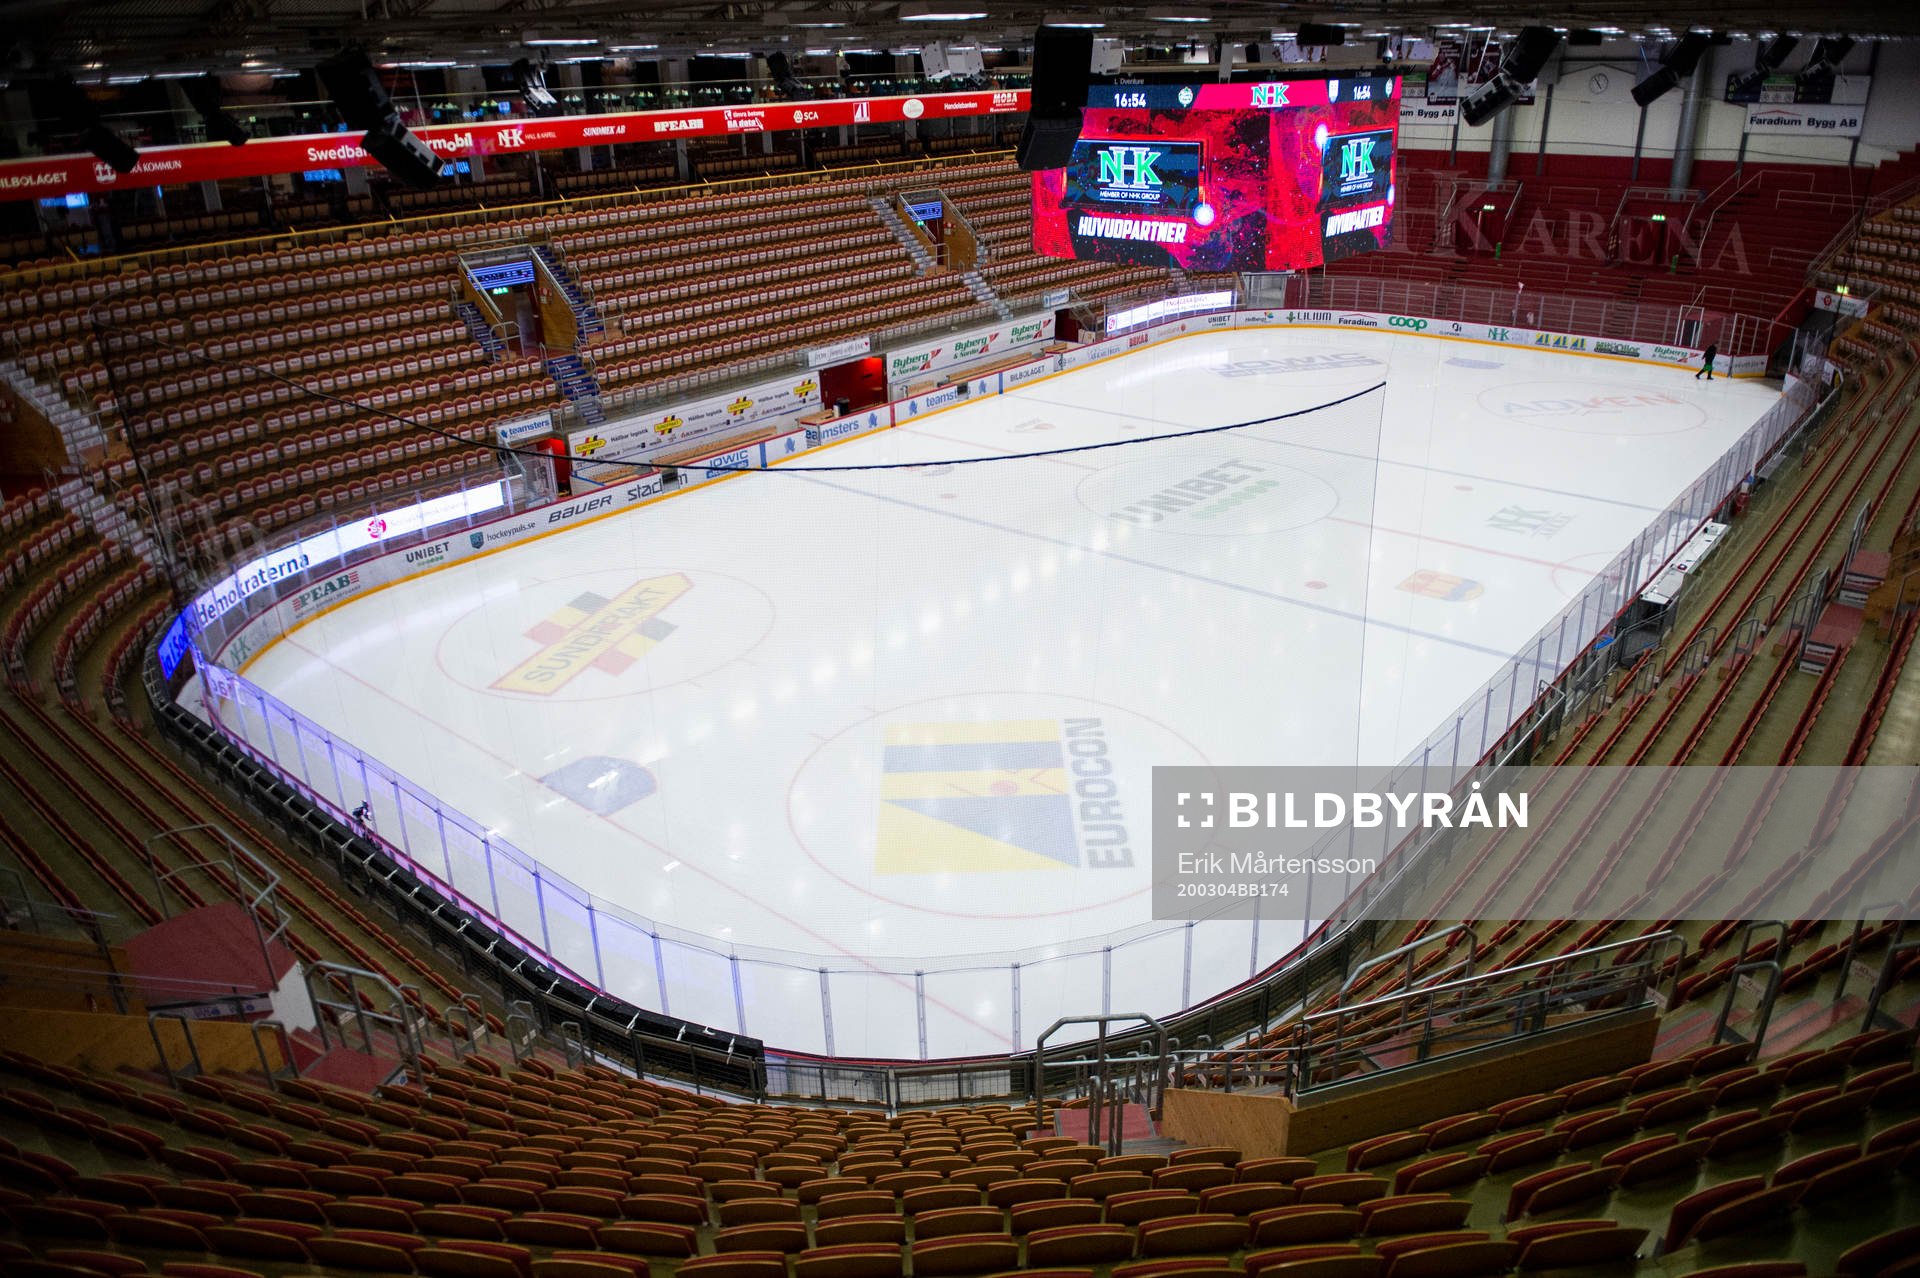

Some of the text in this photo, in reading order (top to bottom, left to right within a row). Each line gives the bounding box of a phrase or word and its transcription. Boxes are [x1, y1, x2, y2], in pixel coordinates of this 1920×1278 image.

[1114, 93, 1146, 107] 16:54
[803, 112, 819, 120] SCA
[1418, 110, 1439, 118] Bygg
[1750, 116, 1857, 128] Faradium Bygg AB
[143, 160, 182, 173] KOMMUN
[1097, 145, 1163, 189] NHK
[1099, 190, 1120, 198] MEMBER
[1141, 192, 1160, 200] GROUP
[1077, 216, 1187, 243] HUVUDPARTNER
[1515, 206, 1753, 275] ARENA
[1208, 315, 1231, 324] UNIBET
[1297, 311, 1332, 321] LILIUM
[1338, 317, 1377, 327] Faradium
[1388, 316, 1427, 331] coop
[1011, 320, 1042, 337] Byberg
[954, 336, 988, 353] Byberg
[1654, 345, 1688, 357] Byberg
[893, 352, 929, 370] Byberg
[1010, 365, 1045, 382] BILBOLAGET
[508, 419, 550, 435] teamsters
[1109, 457, 1266, 524] UNIBET
[548, 495, 612, 524] BAUER
[487, 521, 536, 542] hockeypuls.se
[406, 541, 450, 564] UNIBET
[299, 574, 351, 609] PEAB
[1063, 717, 1135, 868] EUROCON
